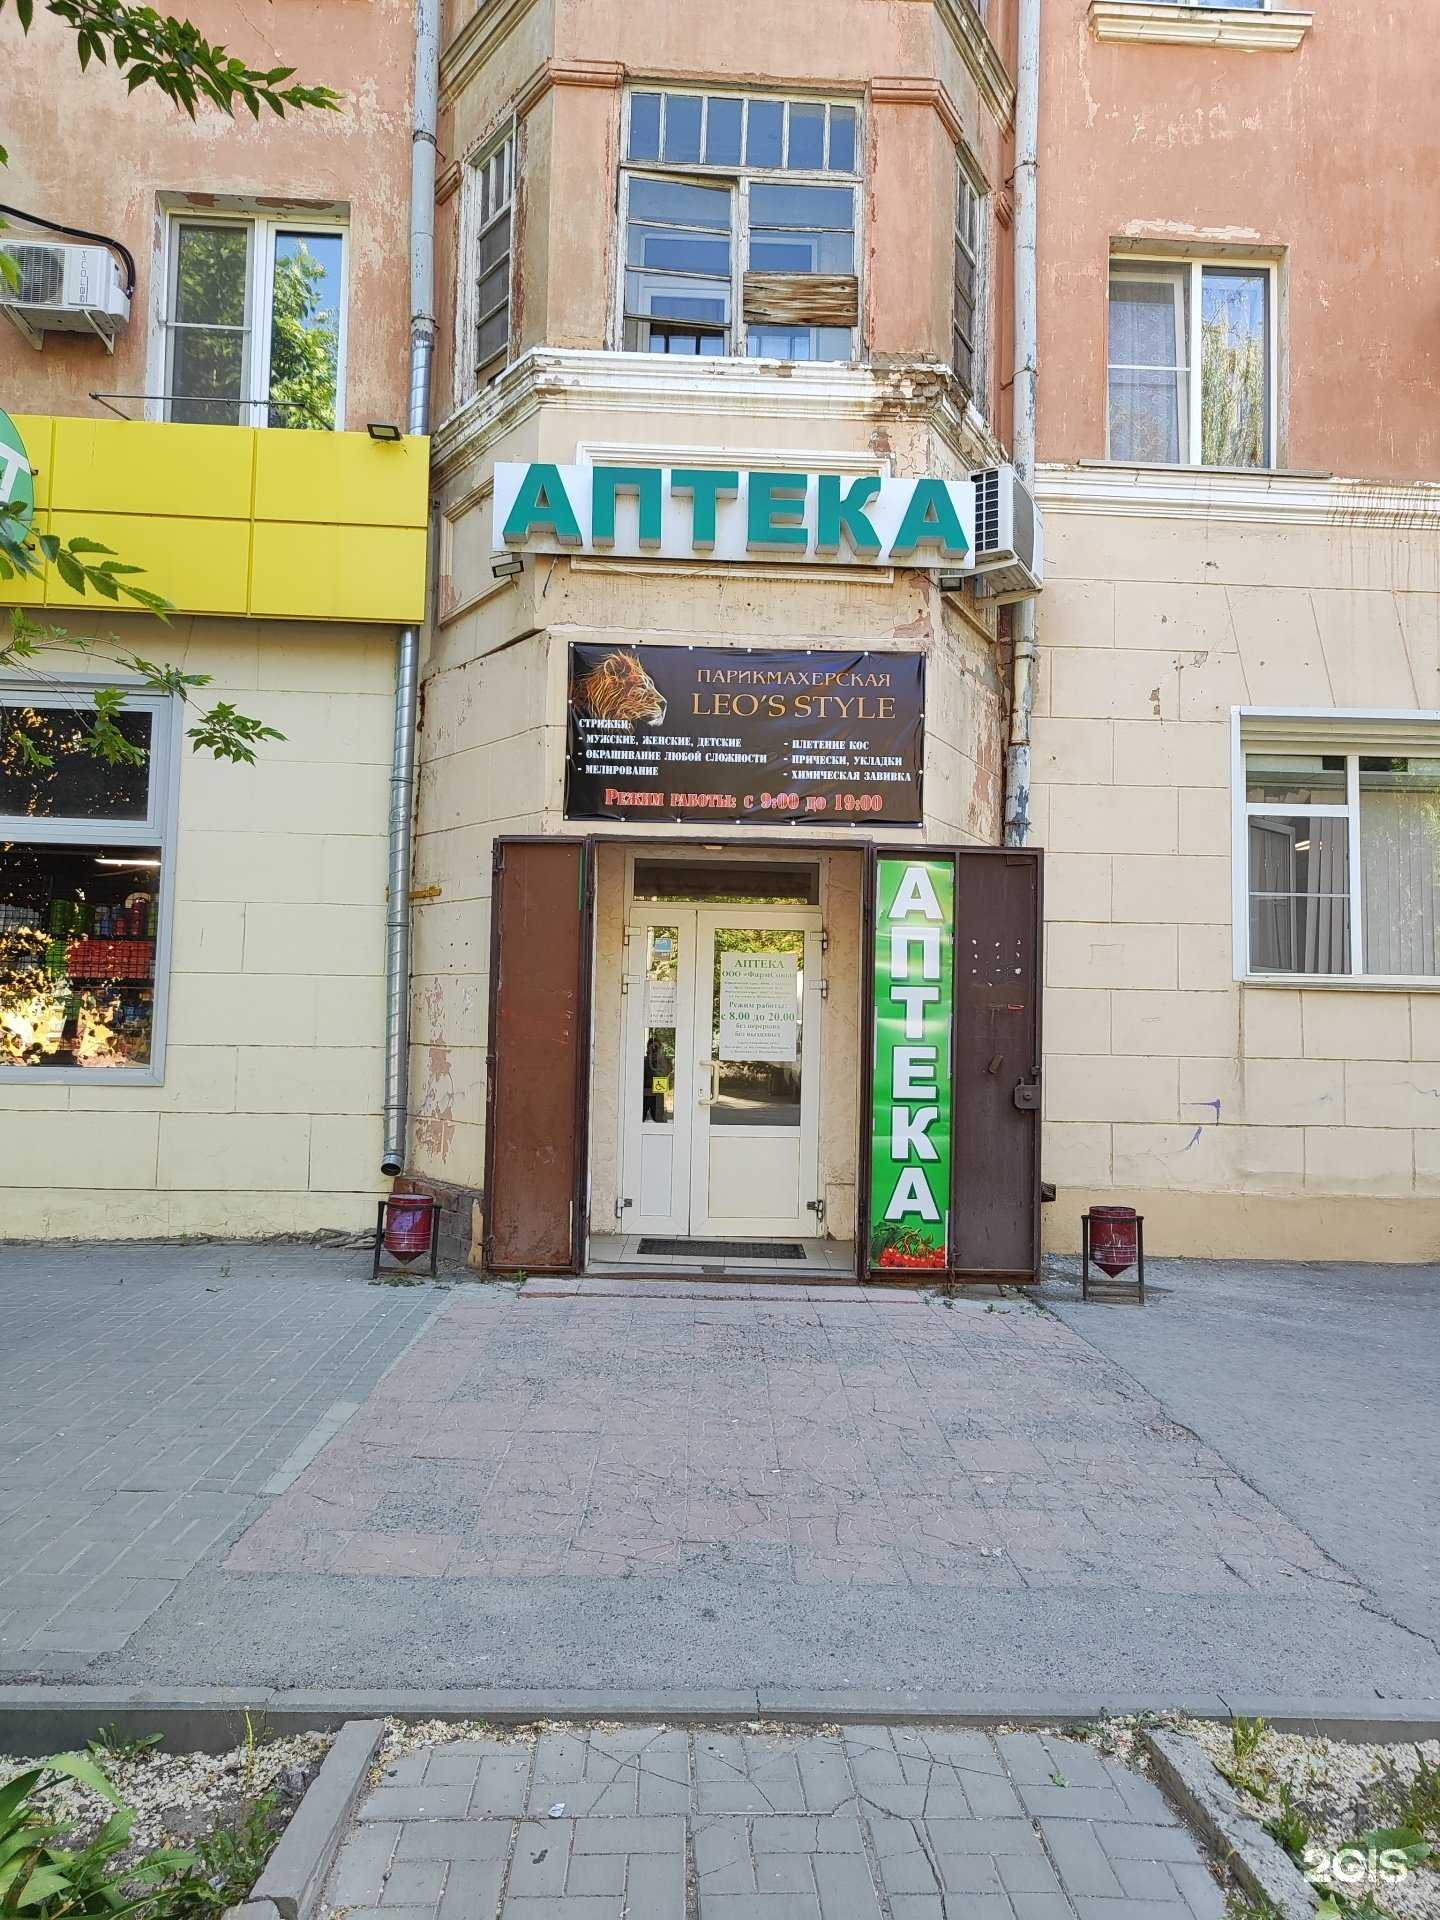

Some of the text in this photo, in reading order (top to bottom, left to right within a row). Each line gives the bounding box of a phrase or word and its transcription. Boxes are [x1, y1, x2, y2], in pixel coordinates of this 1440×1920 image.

[503, 463, 969, 559] АПТЕКА
[696, 669, 891, 687] ПАРИКМАХЕРСКАЯ
[794, 694, 896, 719] STYLE
[578, 718, 632, 730] СТРИЖКИ:
[586, 734, 742, 748] МУЖСКИЕ, ЖЕНСКИЕ, ДЕТСКИЕ
[792, 739, 870, 751] ПЛЕТЕНИЕ КОС
[585, 750, 767, 764] ОКРАШИВАНИЕ ЛЮБОЙ СЛОЖНОСТИ
[791, 755, 903, 767] ПРИЧЕСКИ, УКЛАДКИ
[585, 765, 659, 776] МЕЛИРОВАНИЕ
[791, 770, 912, 782] ХИМИЧЕСКАЯ ЗАВИВКА
[760, 792, 800, 810] 9:00
[834, 793, 883, 811] 19:00
[734, 959, 785, 969] АПТЕКА
[721, 970, 742, 978] ООО
[729, 1001, 753, 1010] Режим
[729, 1011, 751, 1021] 8.00
[752, 1014, 766, 1023] до
[768, 1012, 796, 1023] 20.00
[884, 866, 944, 1222] АПТЕКА
